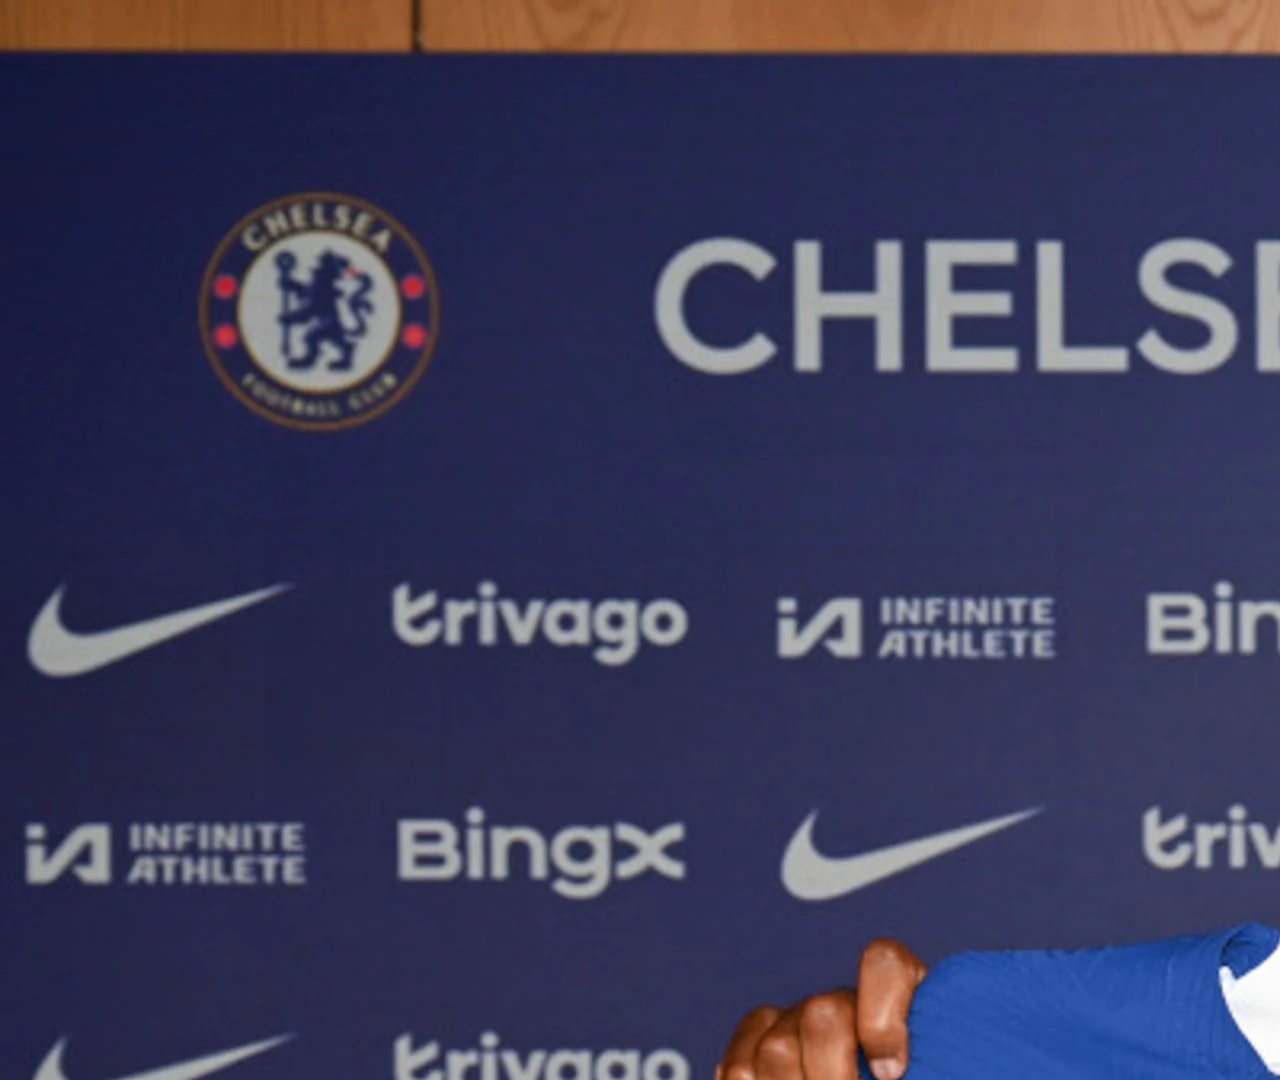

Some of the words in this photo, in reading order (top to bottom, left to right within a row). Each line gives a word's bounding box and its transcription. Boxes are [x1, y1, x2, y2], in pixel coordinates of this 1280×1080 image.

[242, 202, 393, 252] CHELSEA
[393, 582, 687, 666] trivago
[881, 597, 1053, 625] INFINITE
[879, 630, 1053, 657] ATHLETE
[130, 823, 302, 851] INFINITE
[128, 856, 304, 884] ATHLETE
